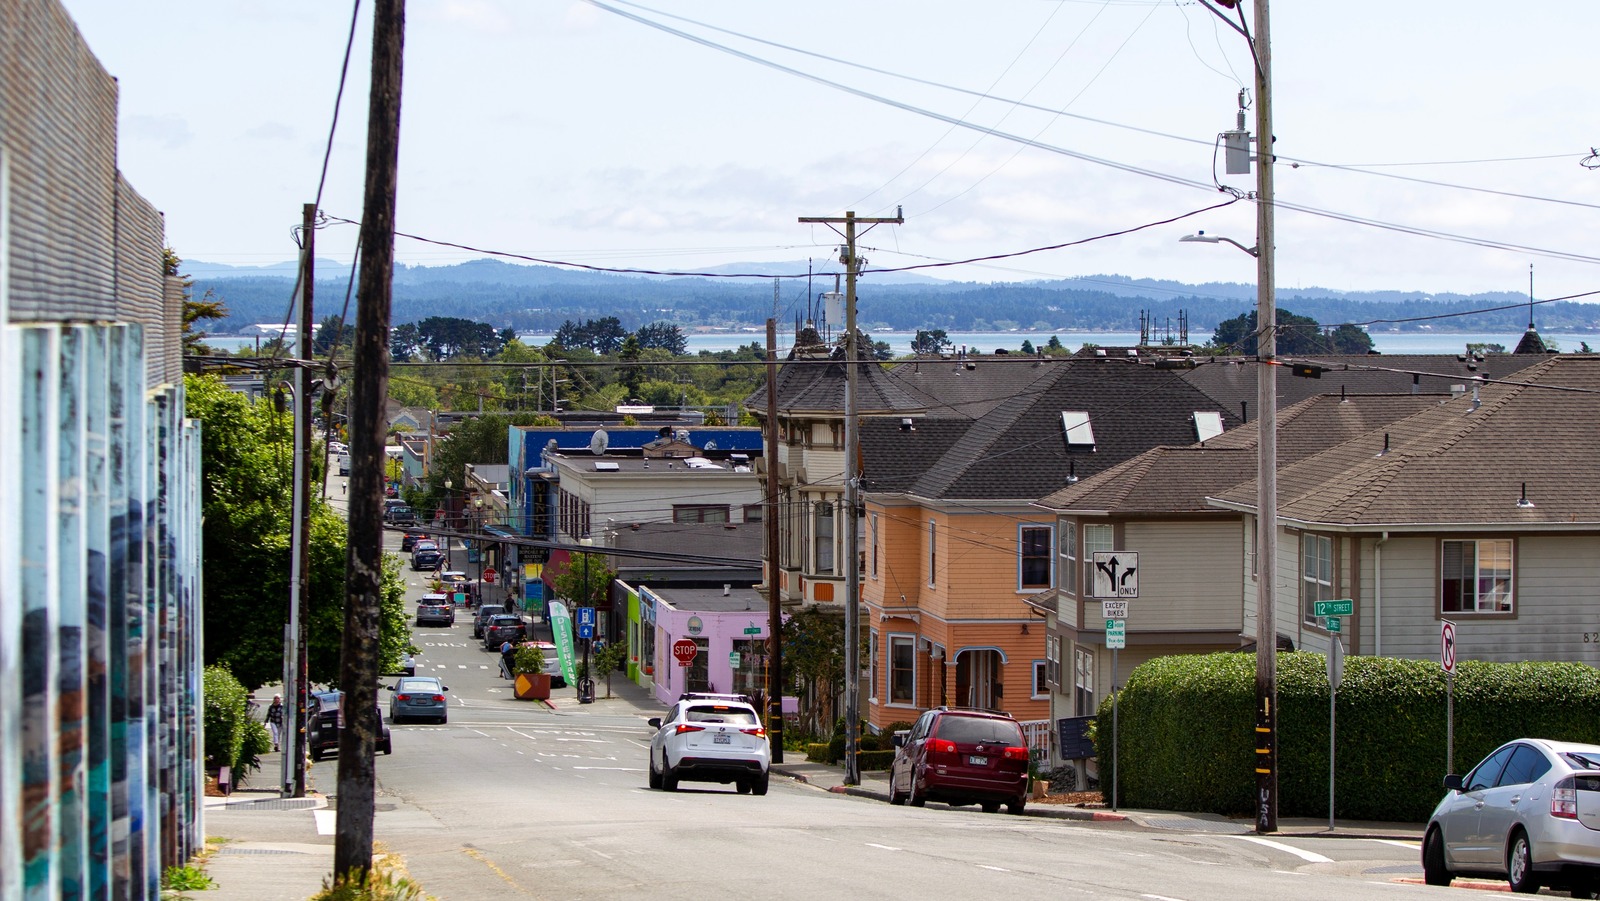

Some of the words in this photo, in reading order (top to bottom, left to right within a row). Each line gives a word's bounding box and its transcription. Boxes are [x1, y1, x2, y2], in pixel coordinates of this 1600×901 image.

[1120, 587, 1136, 595] ONLY
[1333, 603, 1350, 612] STREET
[557, 617, 576, 686] DISPENSARY
[674, 645, 696, 655] STOP
[1259, 788, 1270, 827] USA
